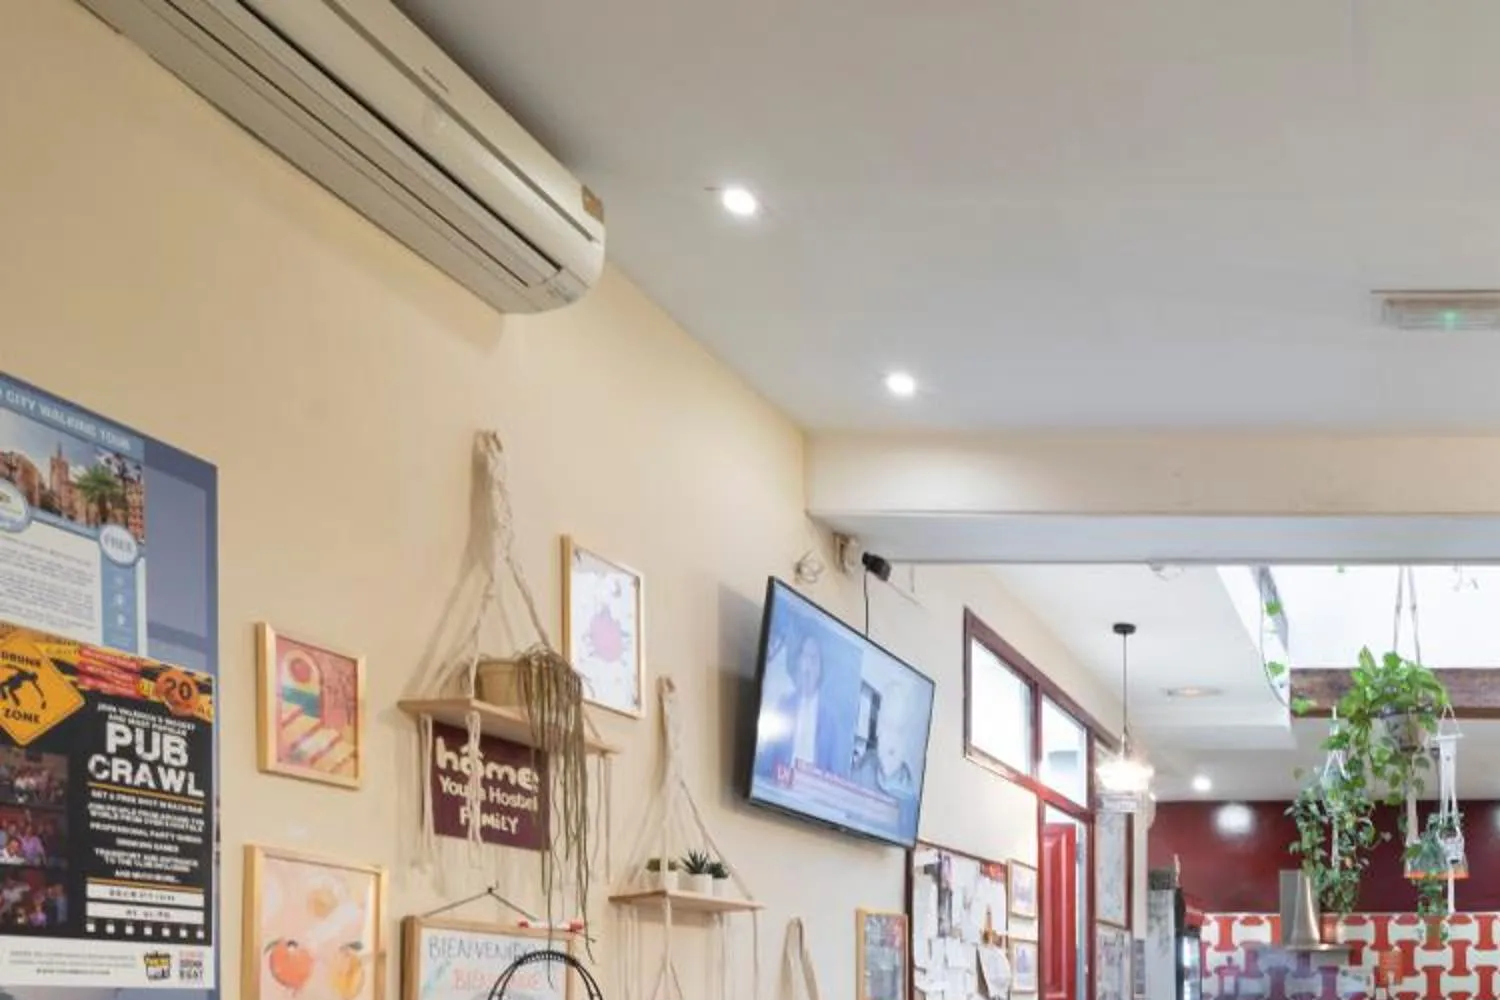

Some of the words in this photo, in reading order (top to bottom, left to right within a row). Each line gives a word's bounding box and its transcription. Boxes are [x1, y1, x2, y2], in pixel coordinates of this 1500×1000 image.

[5, 389, 36, 411] CITY
[4, 709, 41, 724] ZONE
[106, 721, 189, 768] PUB
[88, 754, 205, 798] CRAWL
[439, 775, 487, 801] Youh
